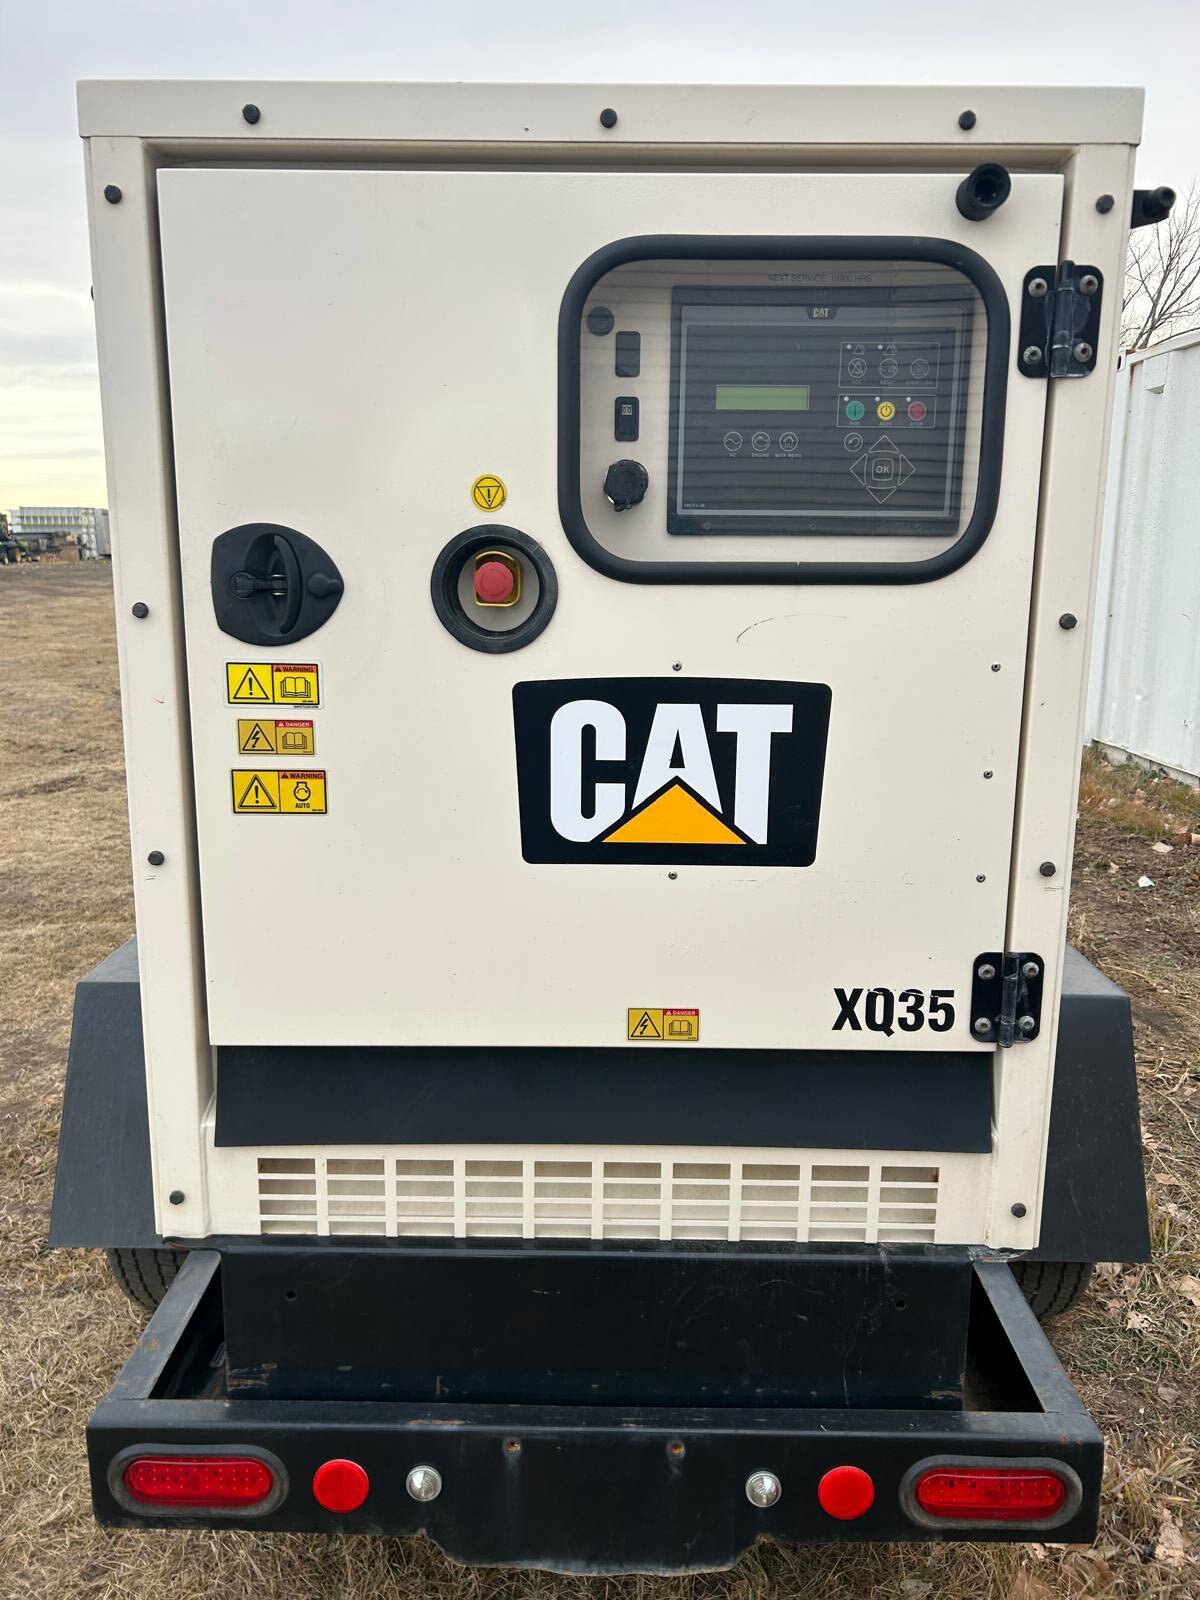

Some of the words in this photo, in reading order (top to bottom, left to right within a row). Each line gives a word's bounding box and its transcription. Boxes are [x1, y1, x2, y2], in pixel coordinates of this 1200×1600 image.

[768, 271, 789, 281] NEXT
[791, 272, 825, 281] SERVICE
[813, 308, 830, 318] CAT
[876, 465, 890, 474] OK
[550, 699, 794, 845] CAT
[831, 987, 956, 1038] XQ35
